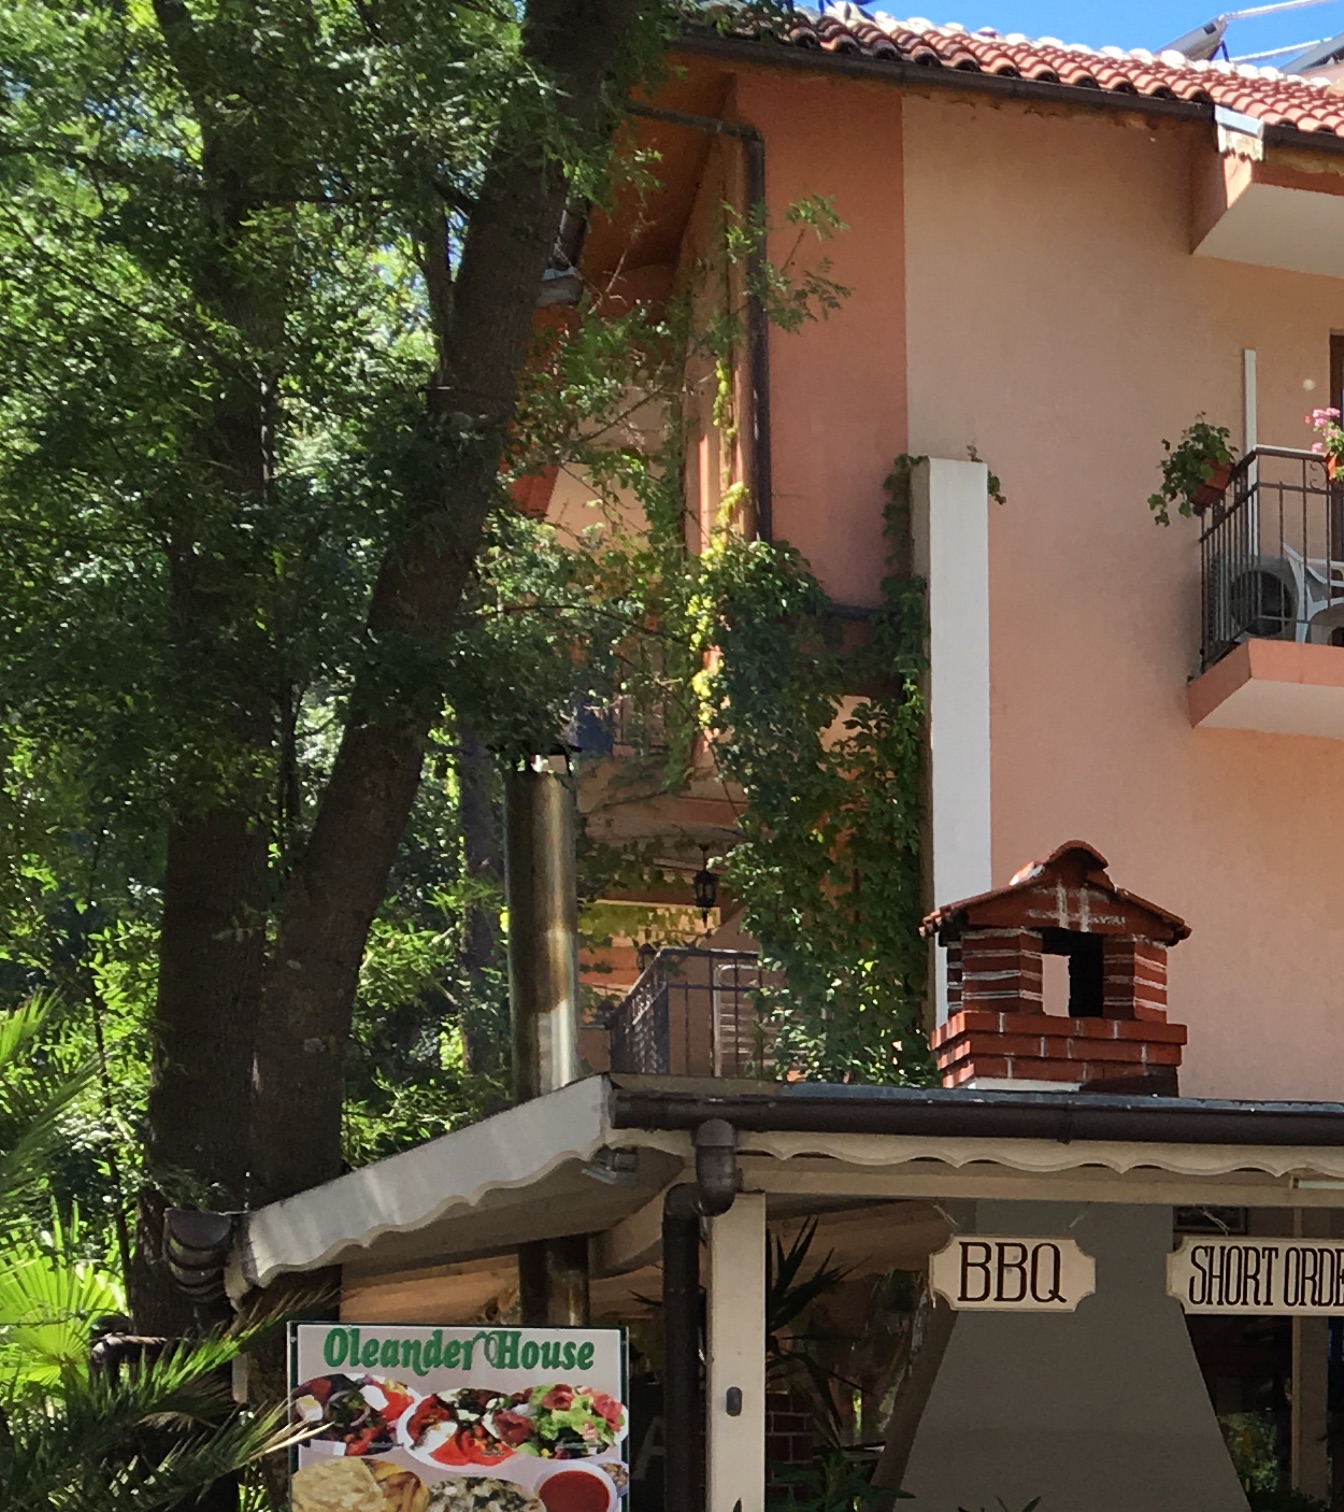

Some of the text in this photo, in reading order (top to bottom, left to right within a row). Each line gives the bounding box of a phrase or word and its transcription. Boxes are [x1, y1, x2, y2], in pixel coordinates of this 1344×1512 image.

[958, 1242, 1067, 1303] BBQ
[1188, 1245, 1277, 1306] SHORT
[323, 1327, 595, 1377] Oleander House
